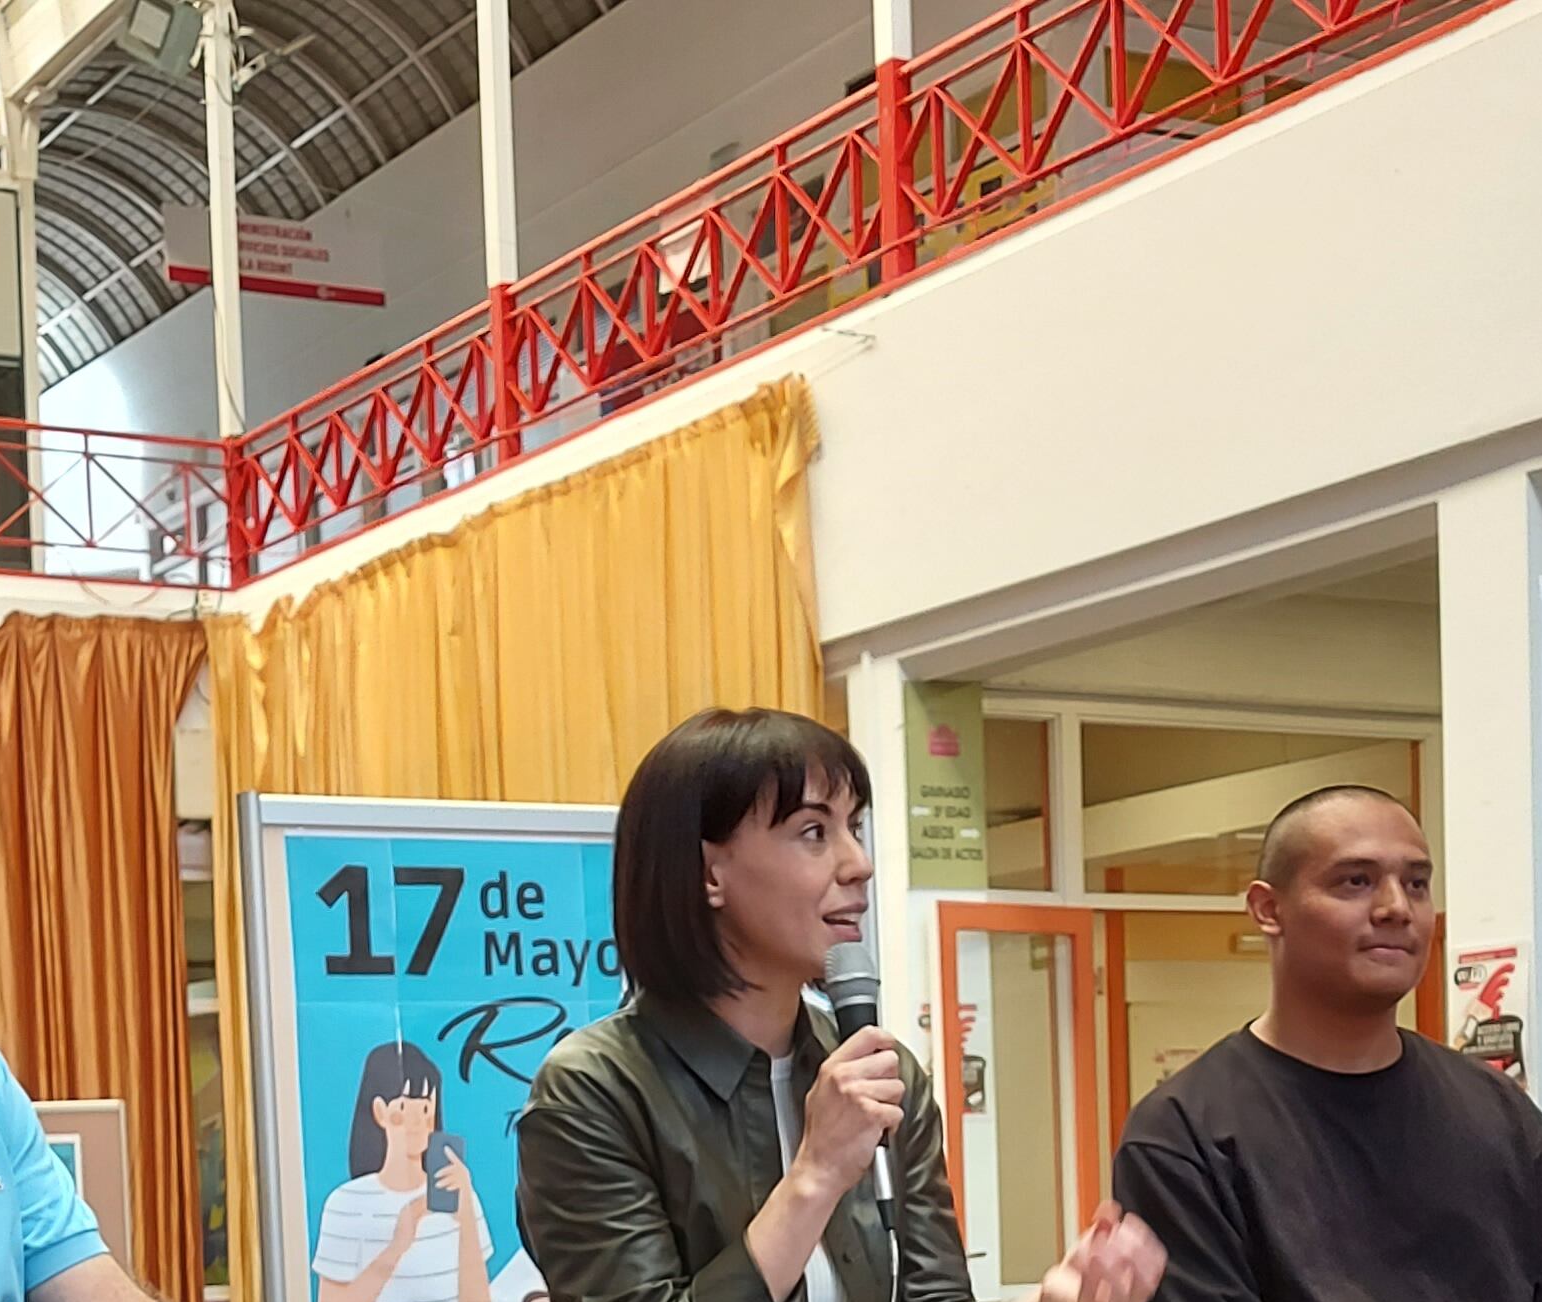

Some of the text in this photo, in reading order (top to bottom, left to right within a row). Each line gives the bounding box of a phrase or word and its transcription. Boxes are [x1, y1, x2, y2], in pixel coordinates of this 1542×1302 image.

[315, 864, 544, 976] 17 de
[484, 931, 621, 986] Mayo
[438, 996, 575, 1083] R
